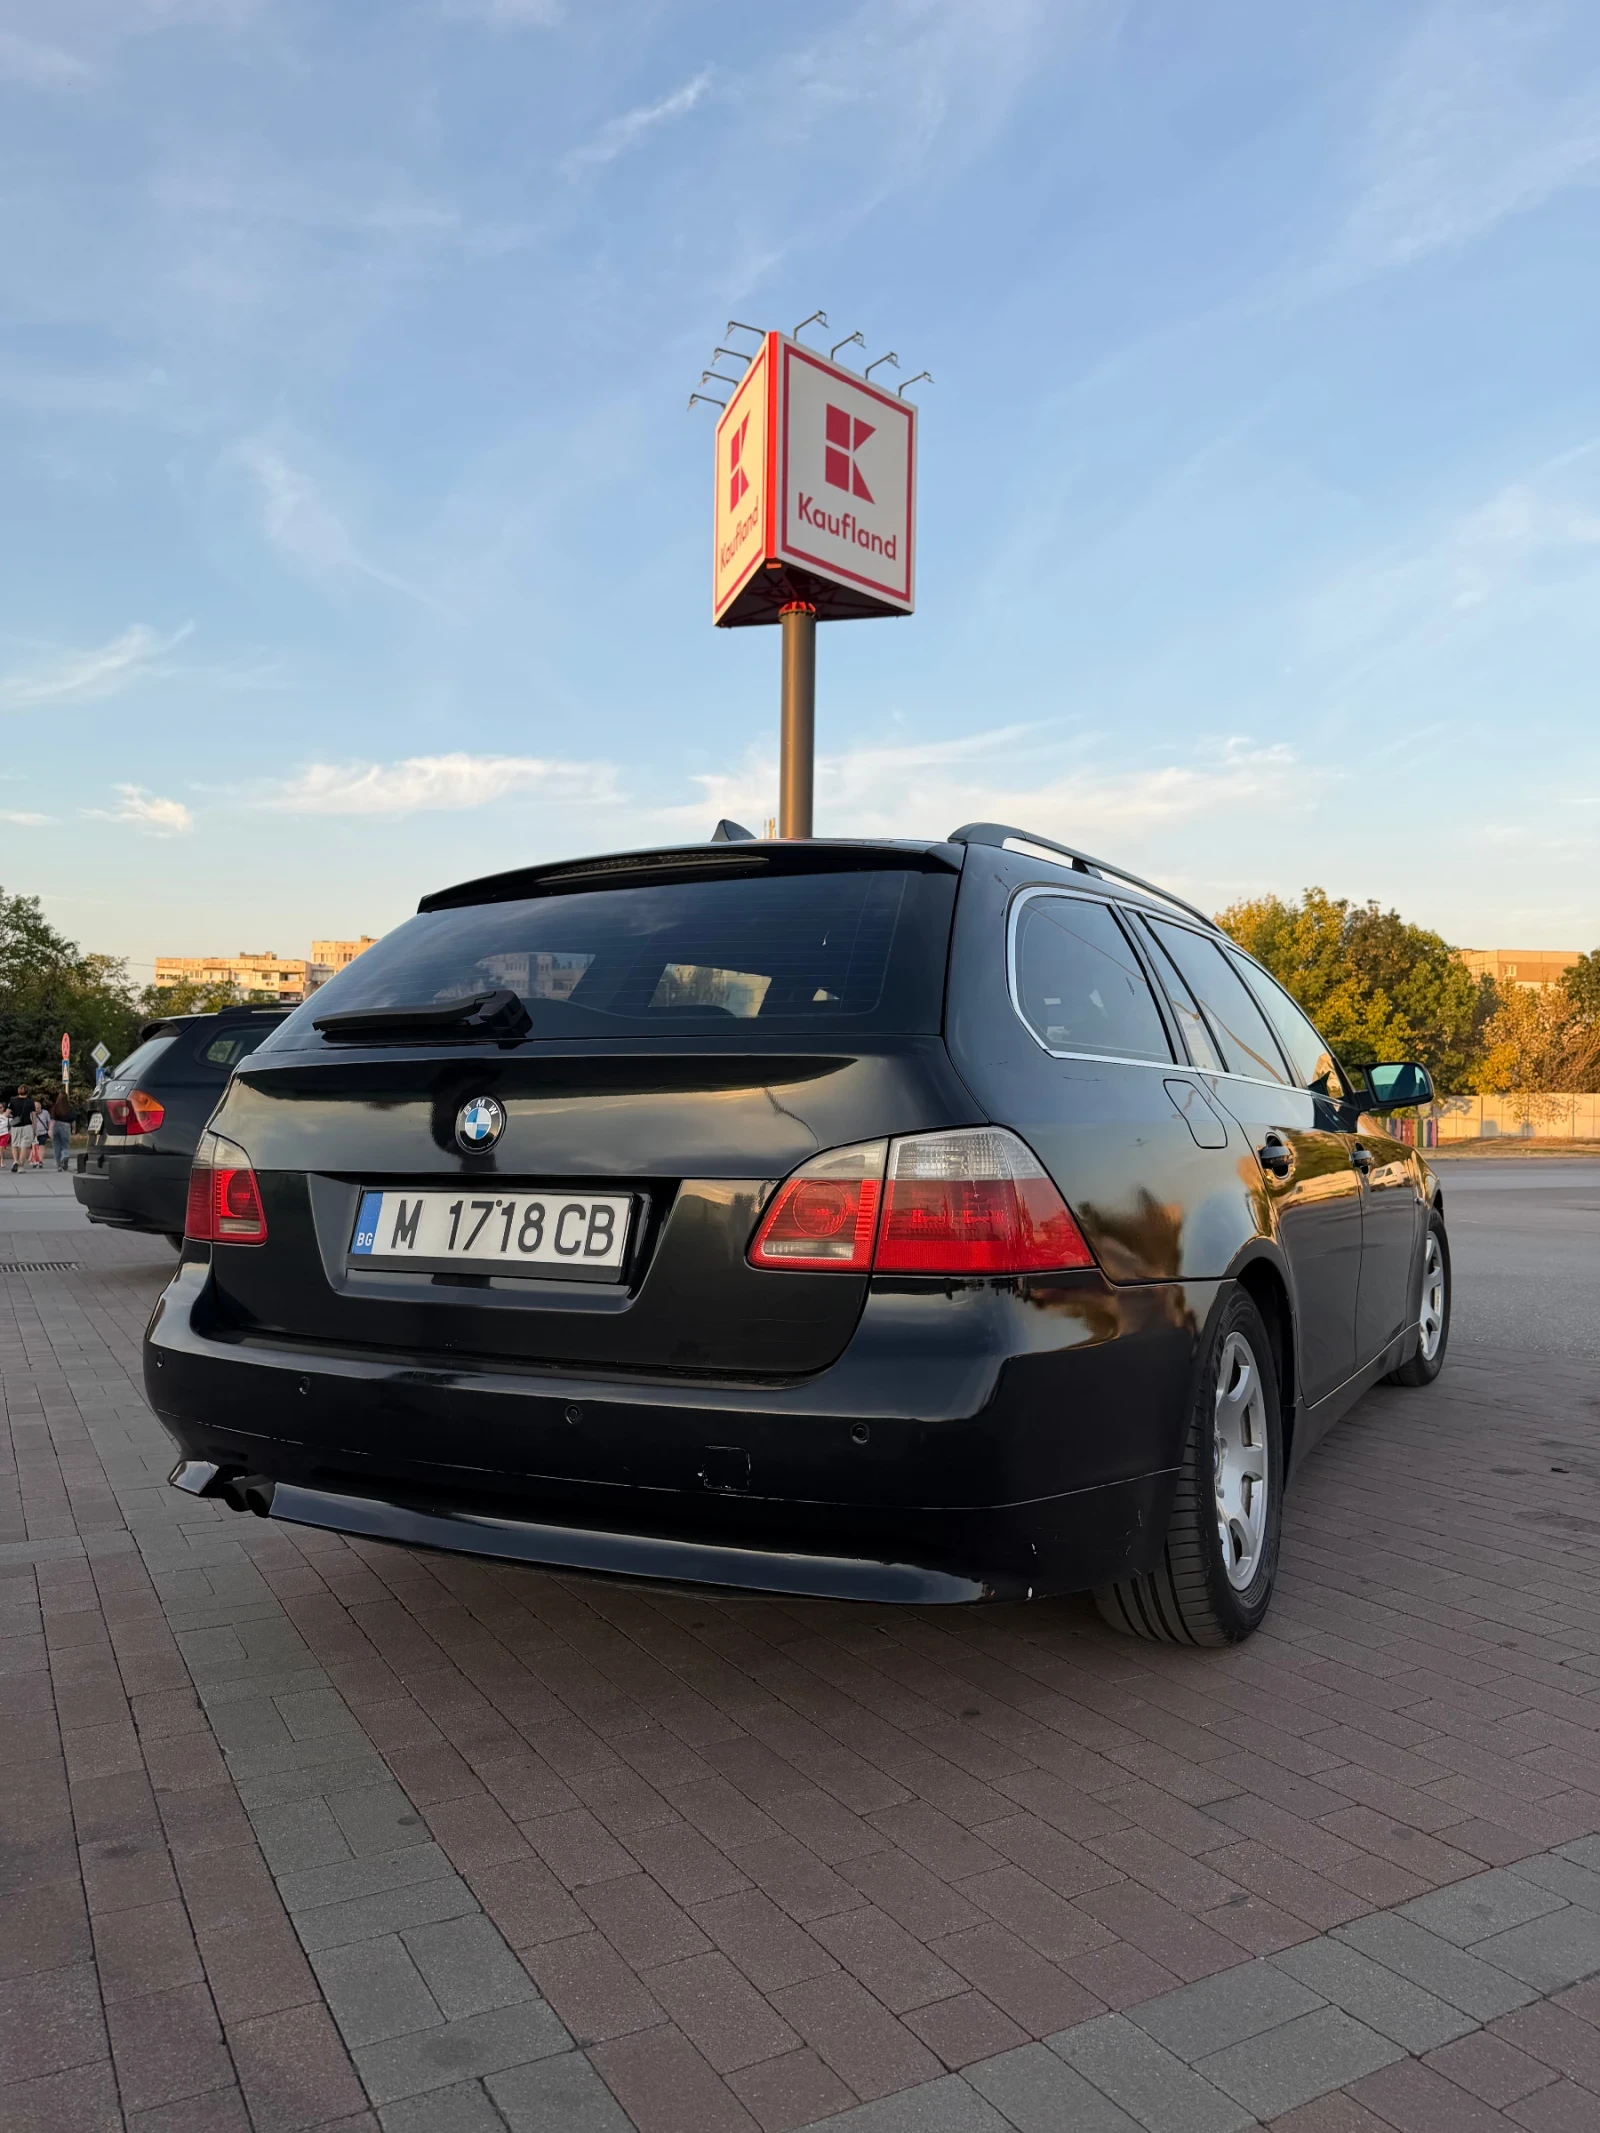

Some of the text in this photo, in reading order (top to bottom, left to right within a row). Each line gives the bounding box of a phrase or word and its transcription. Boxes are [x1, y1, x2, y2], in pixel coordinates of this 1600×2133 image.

[720, 495, 759, 573] Kaufland
[798, 492, 897, 561] Kaufland
[462, 1098, 499, 1115] BMW
[356, 1232, 374, 1246] BG
[390, 1199, 424, 1249] M
